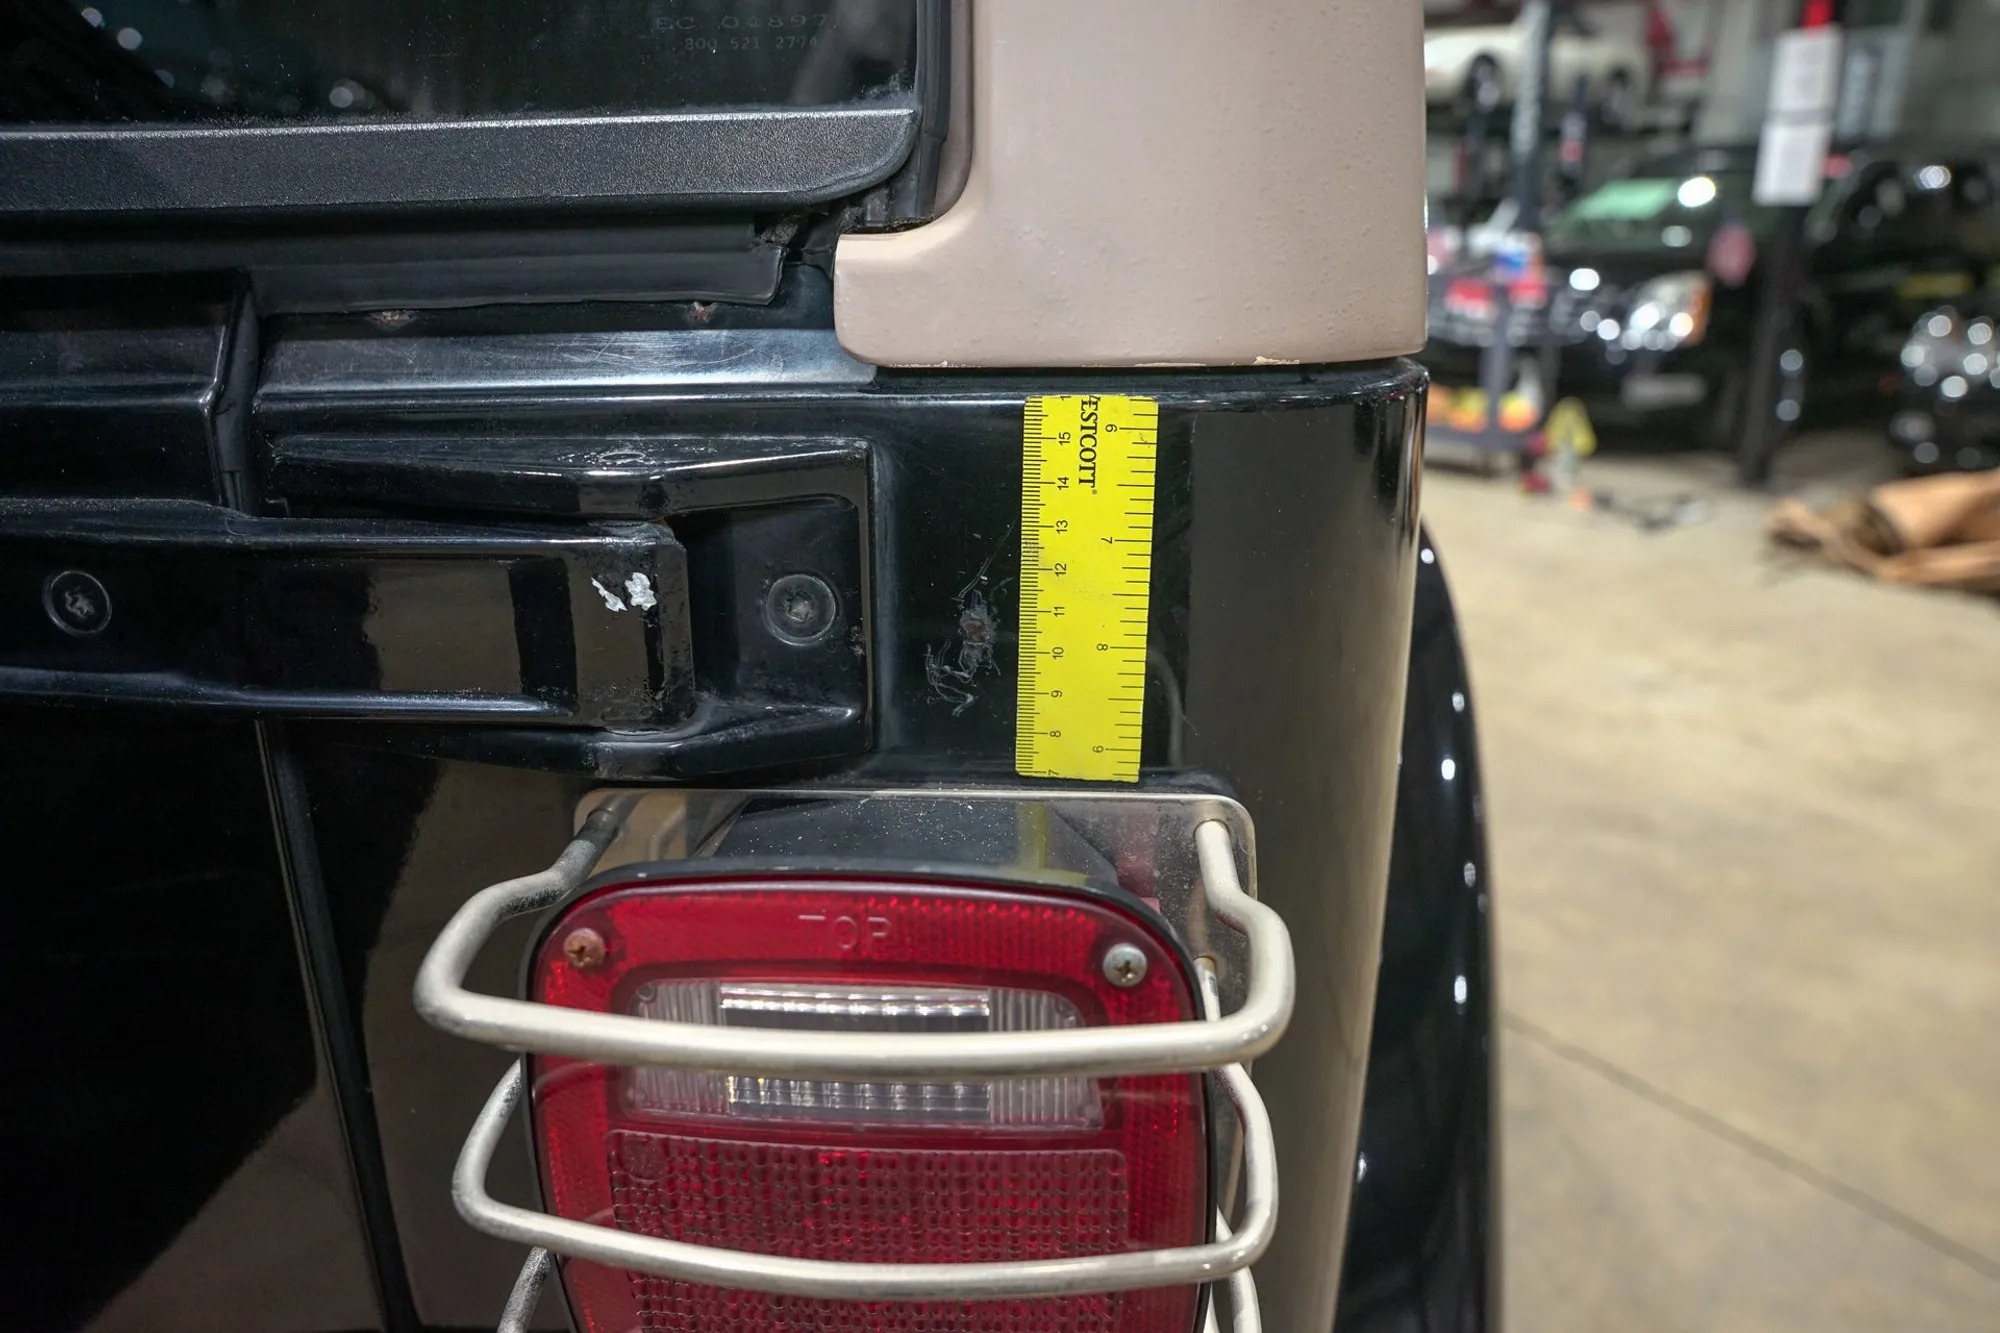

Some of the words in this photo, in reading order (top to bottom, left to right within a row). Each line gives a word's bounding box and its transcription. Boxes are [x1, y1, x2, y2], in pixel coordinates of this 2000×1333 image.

[1058, 431, 1071, 446] 15
[1057, 476, 1069, 490] 14
[1055, 519, 1069, 534] 13
[1100, 536, 1113, 544] 7
[1054, 562, 1067, 577] 12
[1053, 606, 1065, 617] 11
[1051, 646, 1064, 660] 10
[1096, 643, 1108, 651] 8
[1049, 730, 1062, 738] 8
[797, 914, 893, 951] TOP
